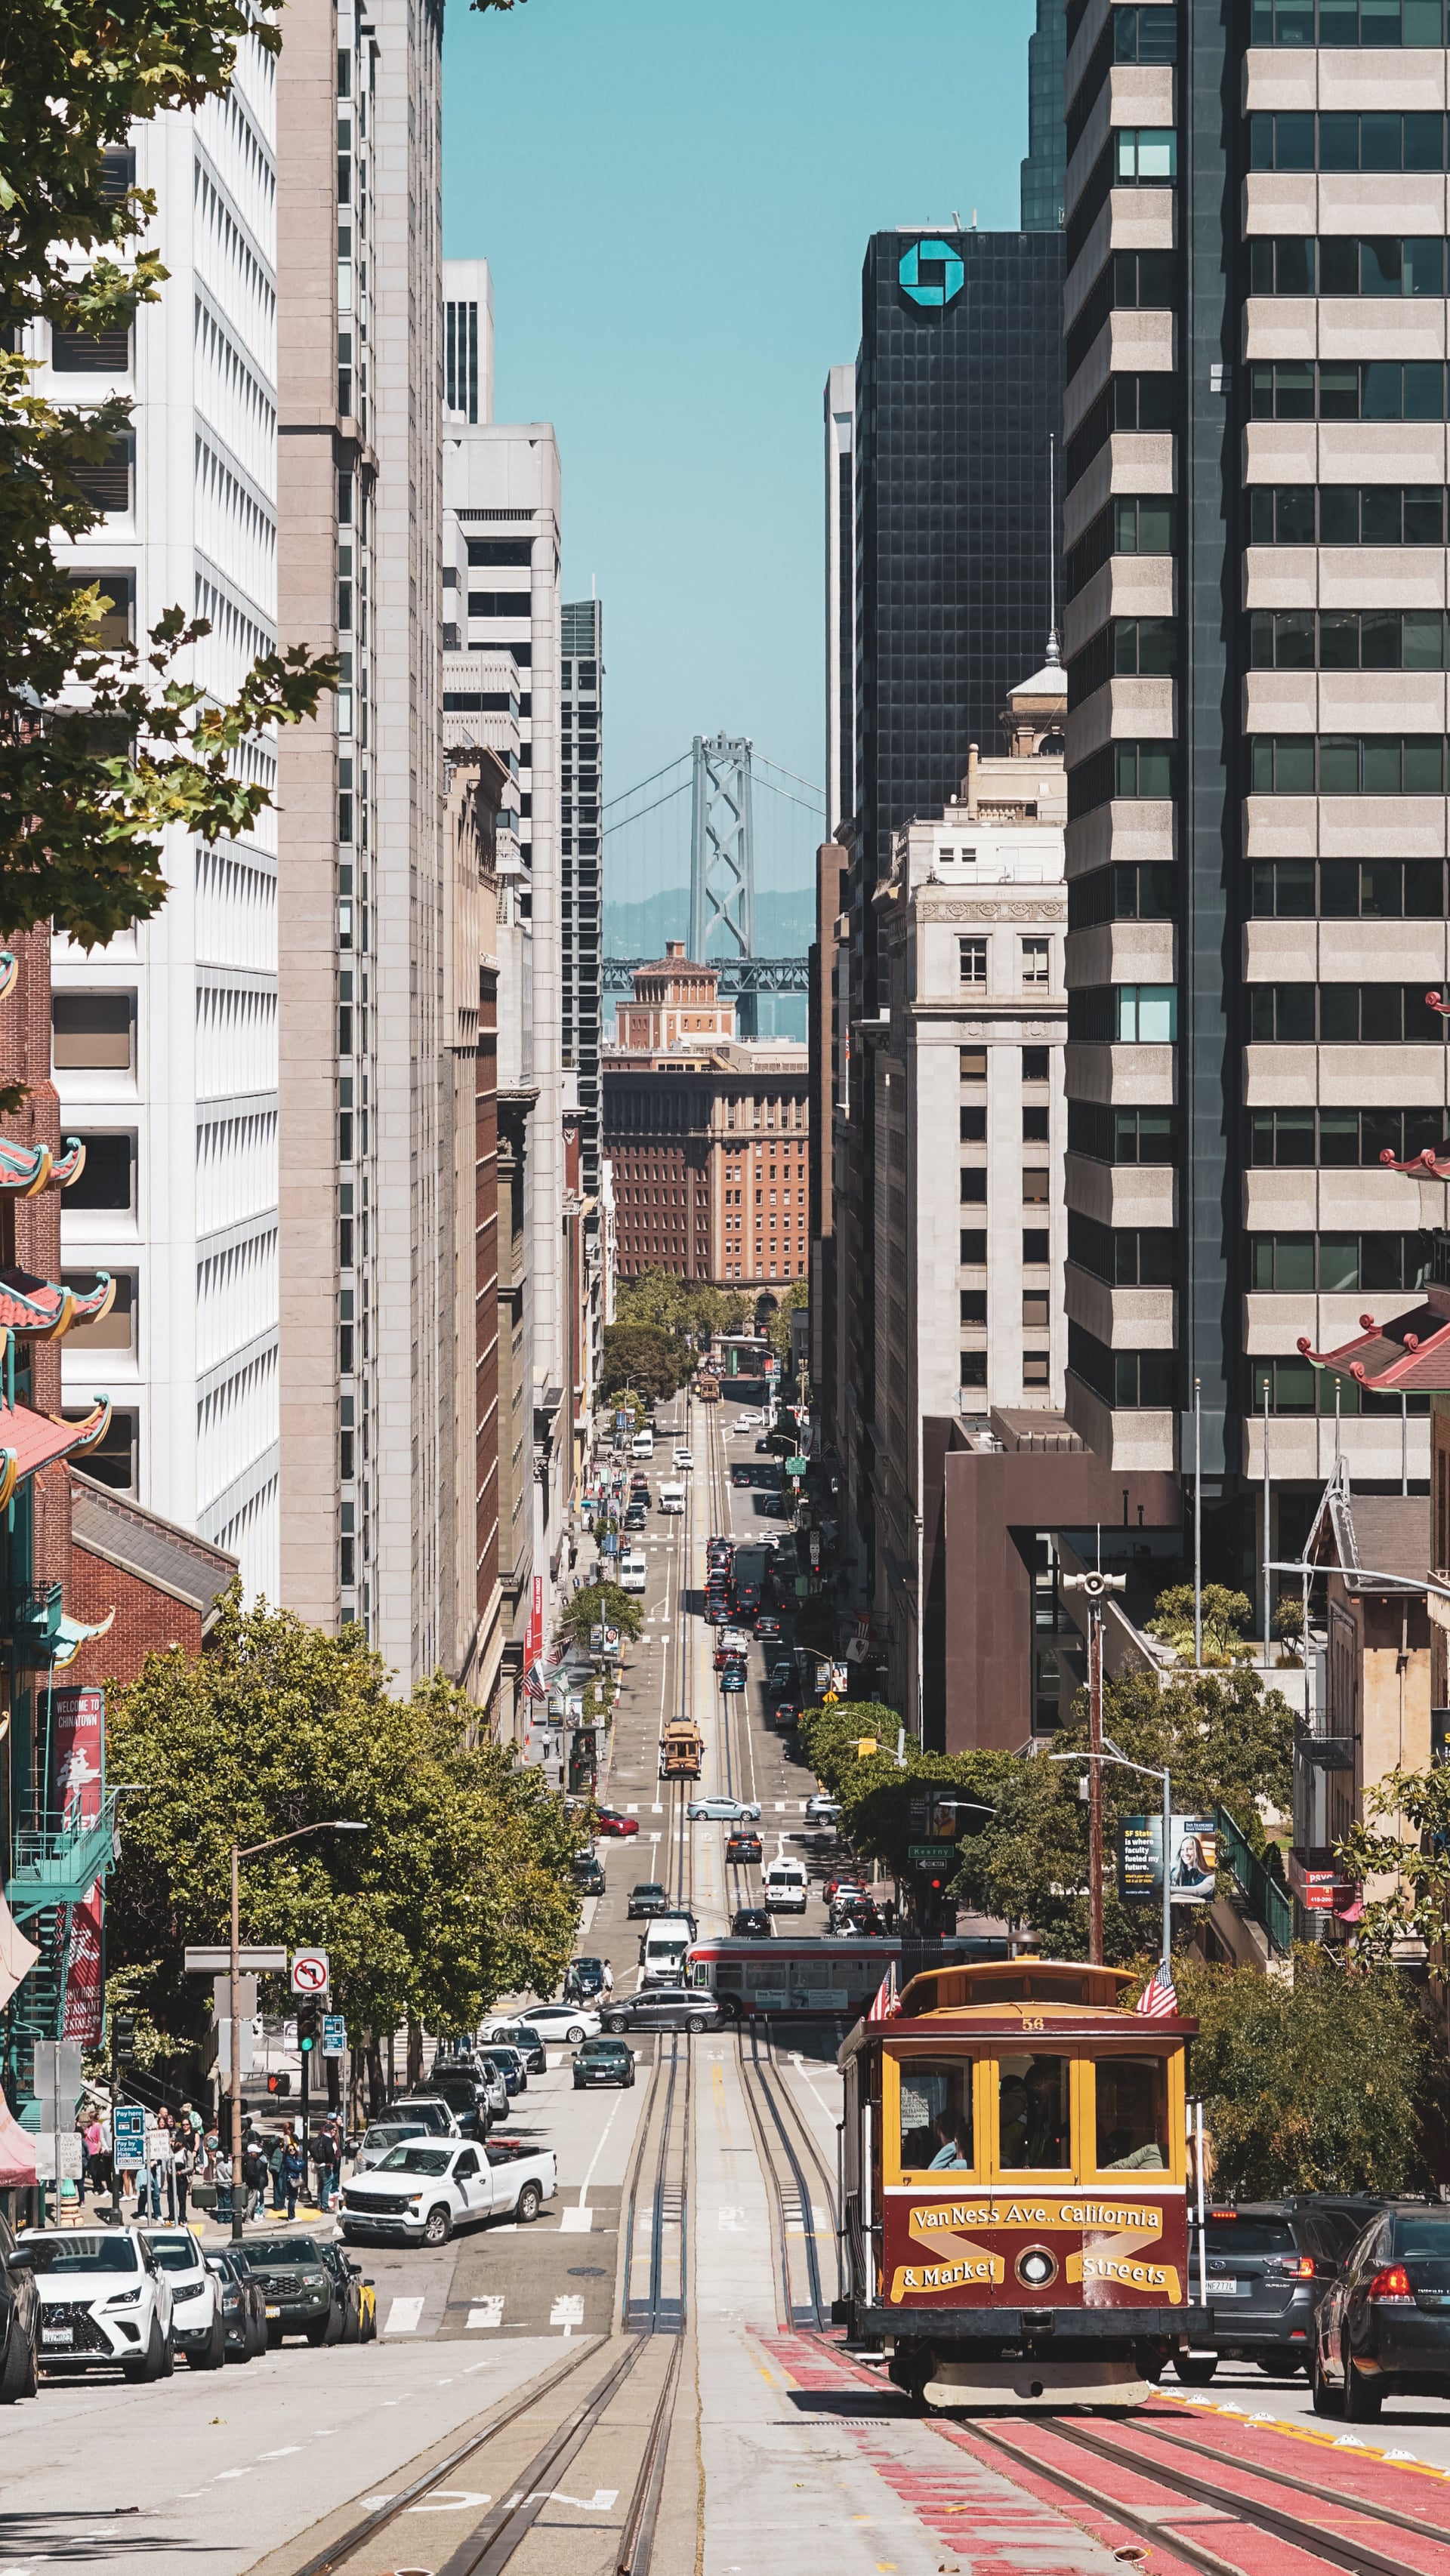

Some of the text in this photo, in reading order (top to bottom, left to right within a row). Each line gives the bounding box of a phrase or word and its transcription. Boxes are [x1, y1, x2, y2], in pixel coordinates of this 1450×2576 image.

[57, 1699, 100, 1713] WELCOME TO
[58, 1714, 97, 1728] CHINATOWN
[1125, 1847, 1149, 1855] faculty
[81, 1985, 101, 1999] HOUSE
[64, 2001, 101, 2016] STAURANT
[1022, 2017, 1044, 2031] 56
[915, 2211, 950, 2229] Van
[952, 2206, 1001, 2225] Ness
[1059, 2205, 1160, 2228] California
[902, 2259, 996, 2287] & Market
[1082, 2257, 1168, 2285] Streets
